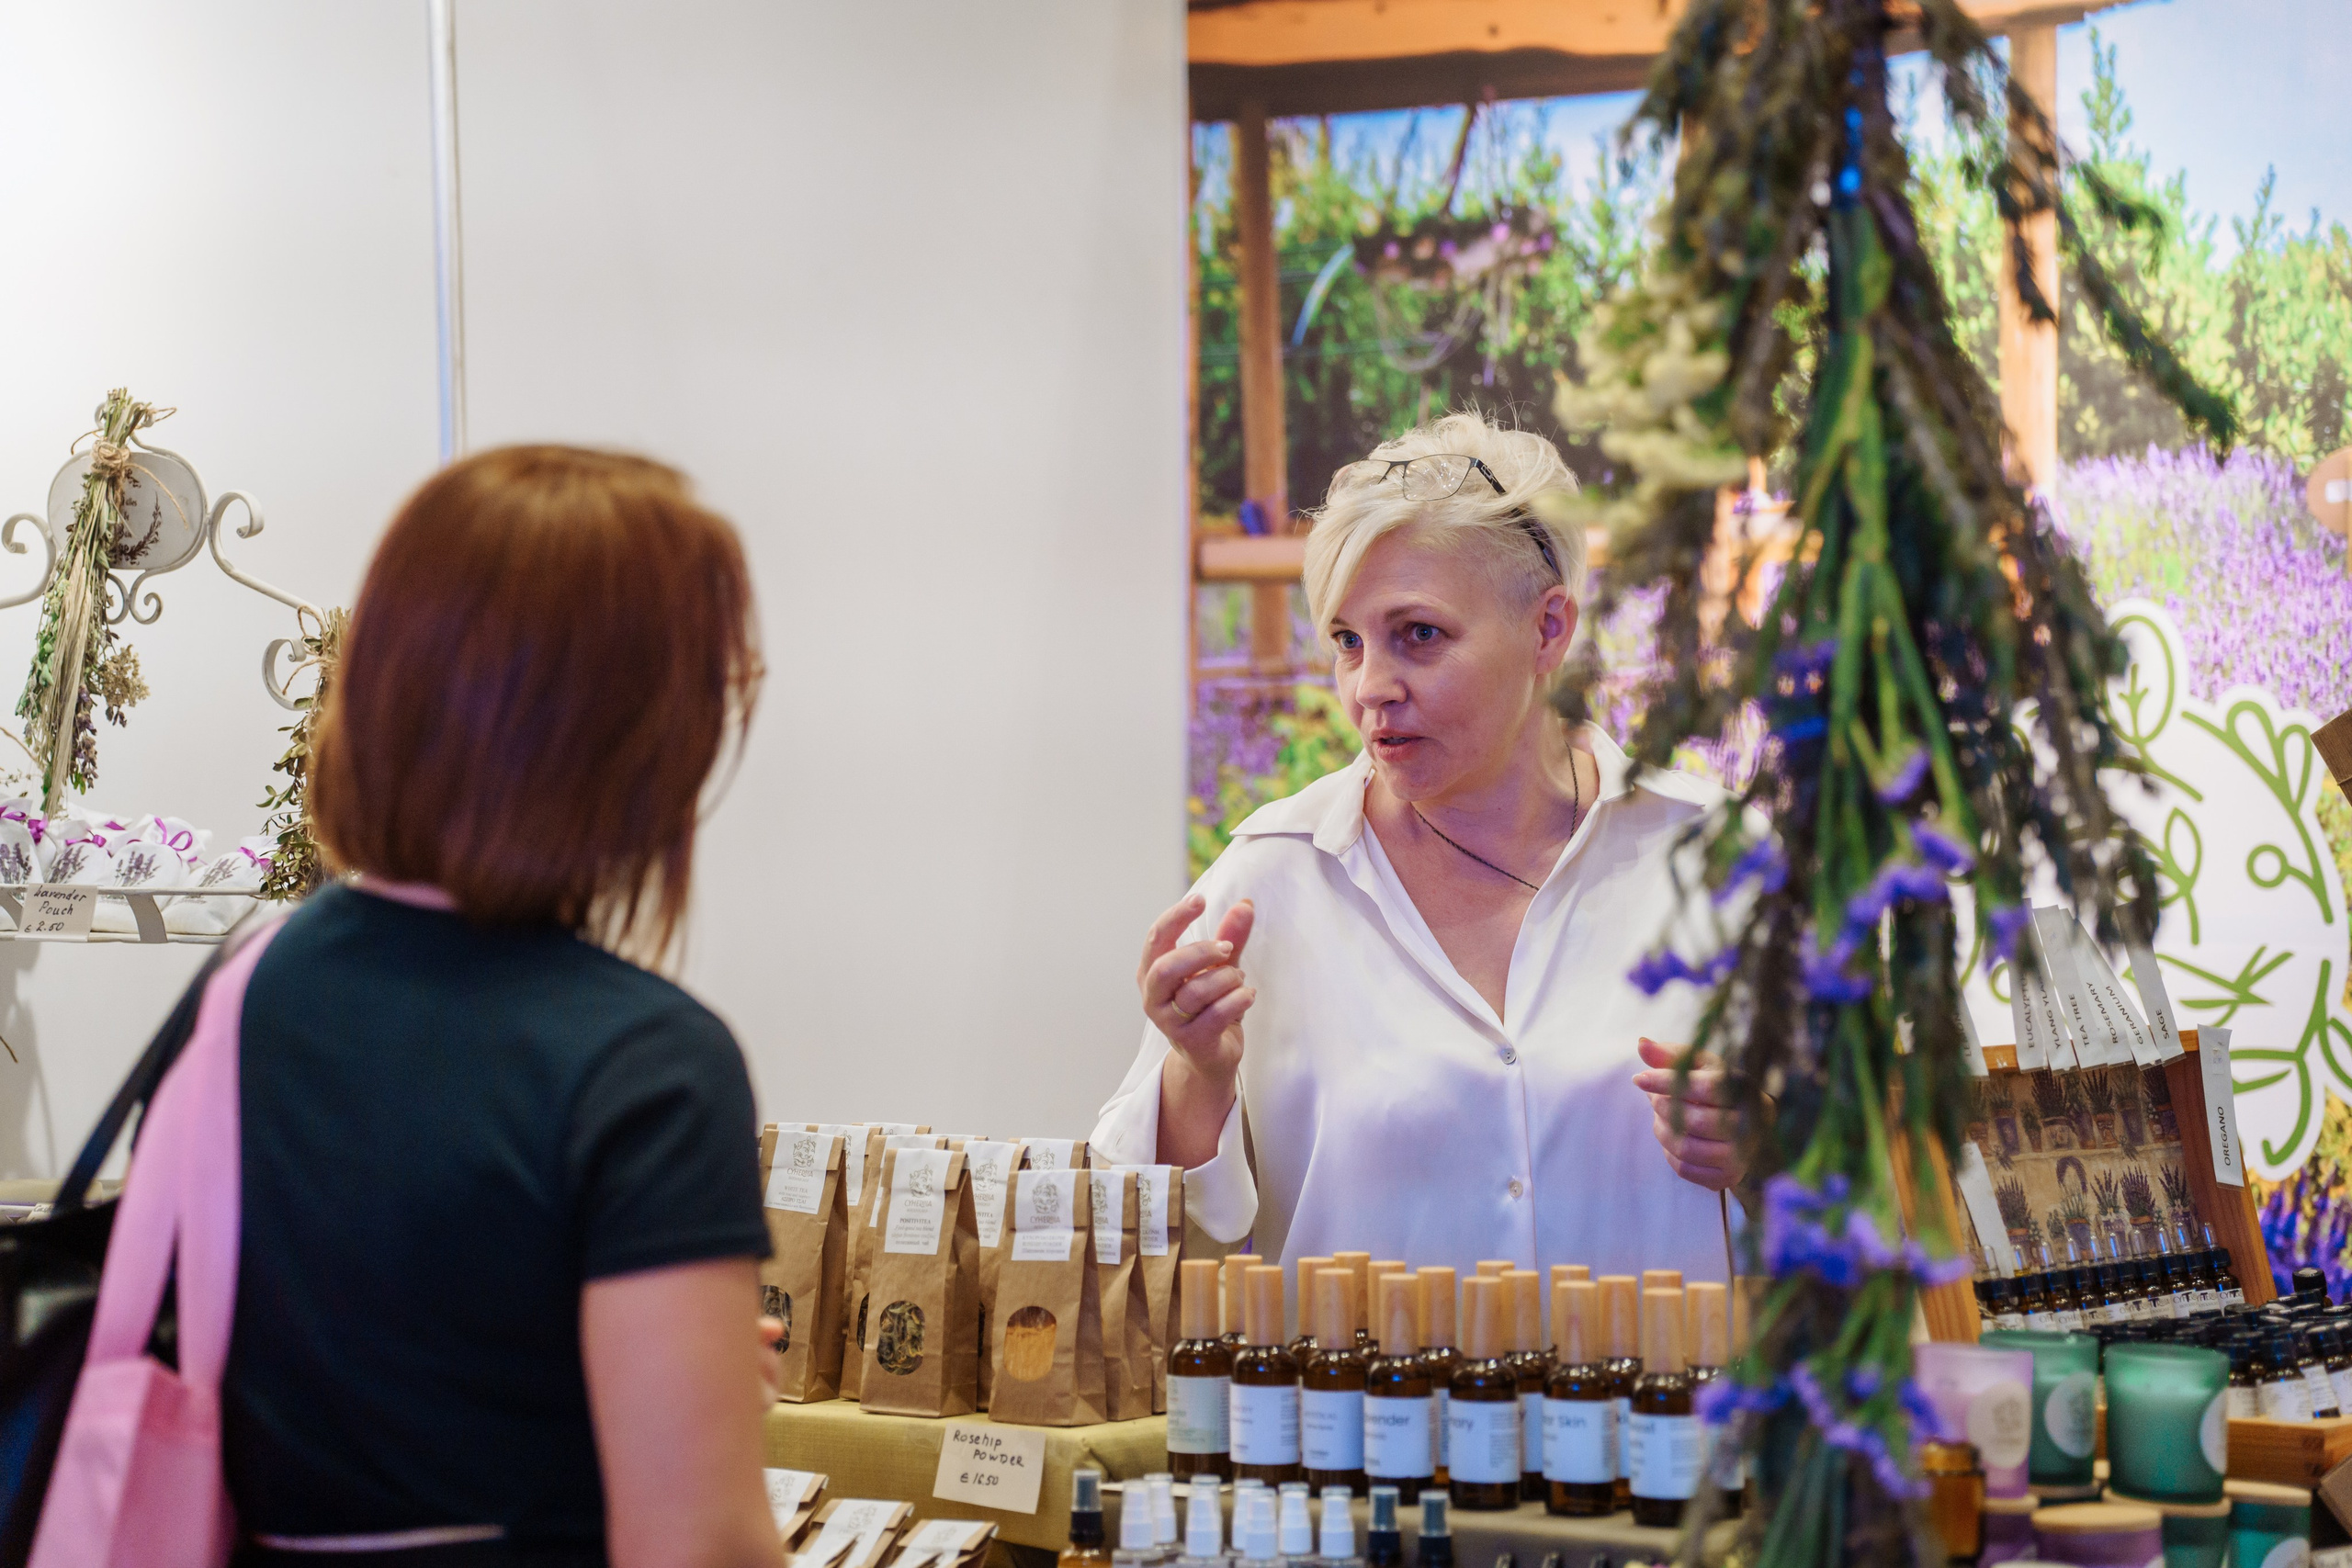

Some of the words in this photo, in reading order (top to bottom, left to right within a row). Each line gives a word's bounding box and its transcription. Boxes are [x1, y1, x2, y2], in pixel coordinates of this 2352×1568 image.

[39, 900, 74, 916] Pouch
[36, 920, 64, 932] 2.50
[2068, 993, 2082, 1022] TREE
[2086, 981, 2119, 1044] ROSEMARY
[2105, 986, 2143, 1045] GERANIUM
[2046, 1010, 2061, 1049] YLANG
[2079, 1024, 2090, 1047] TEA
[2155, 1009, 2170, 1040] SAGE
[2217, 1106, 2232, 1167] OREGANO
[1557, 1413, 1587, 1428] Skin
[953, 1429, 1002, 1451] Rosehip
[960, 1472, 969, 1483] €
[972, 1472, 1000, 1486] 16.50
